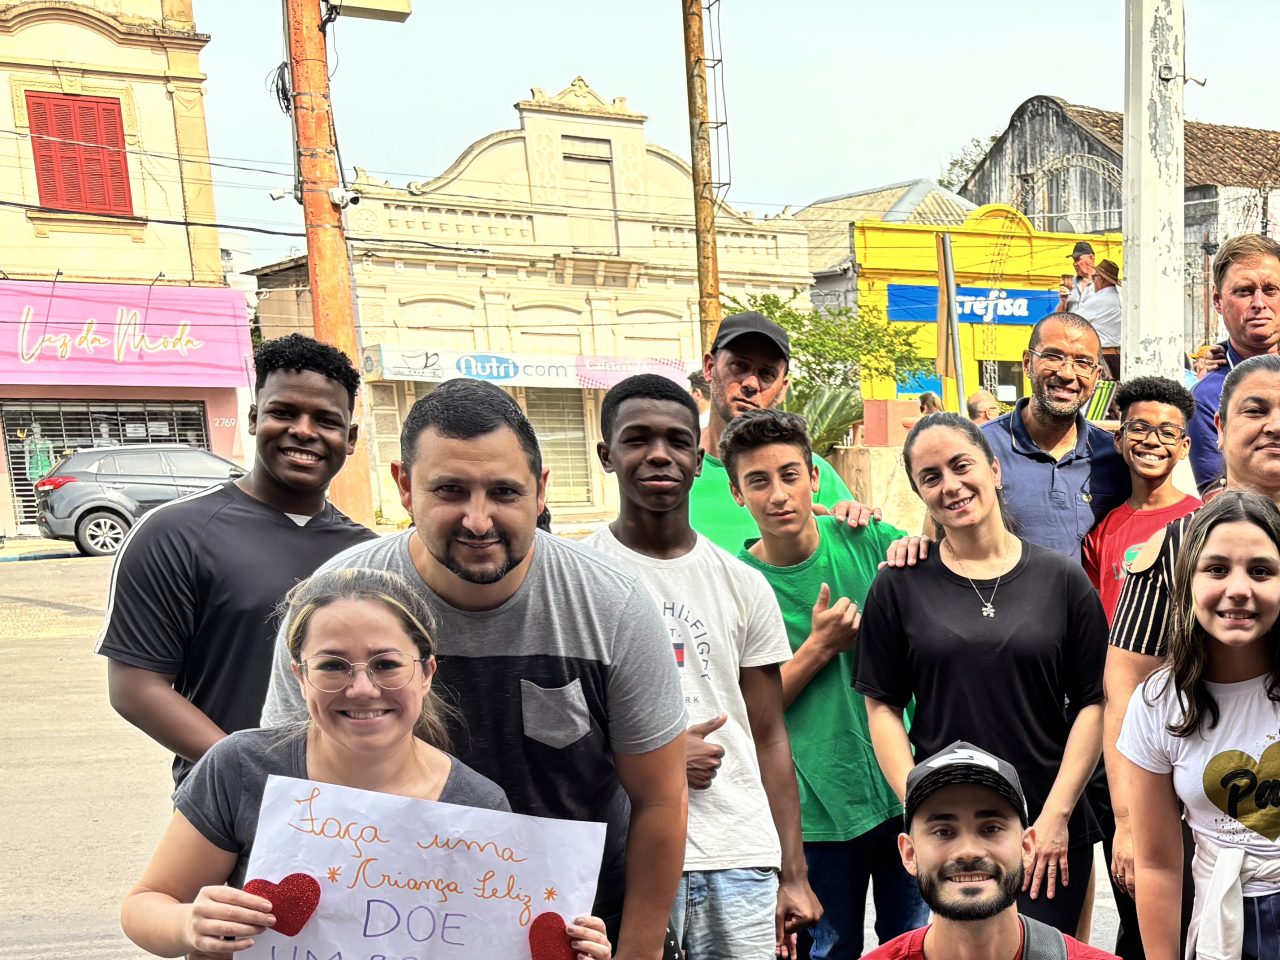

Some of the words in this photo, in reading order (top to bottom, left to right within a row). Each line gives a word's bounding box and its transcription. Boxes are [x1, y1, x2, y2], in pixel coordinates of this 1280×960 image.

[77, 319, 110, 353] da
[114, 306, 203, 362] Moda
[457, 355, 516, 378] Nutri
[523, 363, 568, 378] com
[214, 417, 236, 428] 2769
[288, 787, 390, 858] Faça
[416, 834, 529, 863] uma
[362, 899, 468, 946] DOE
